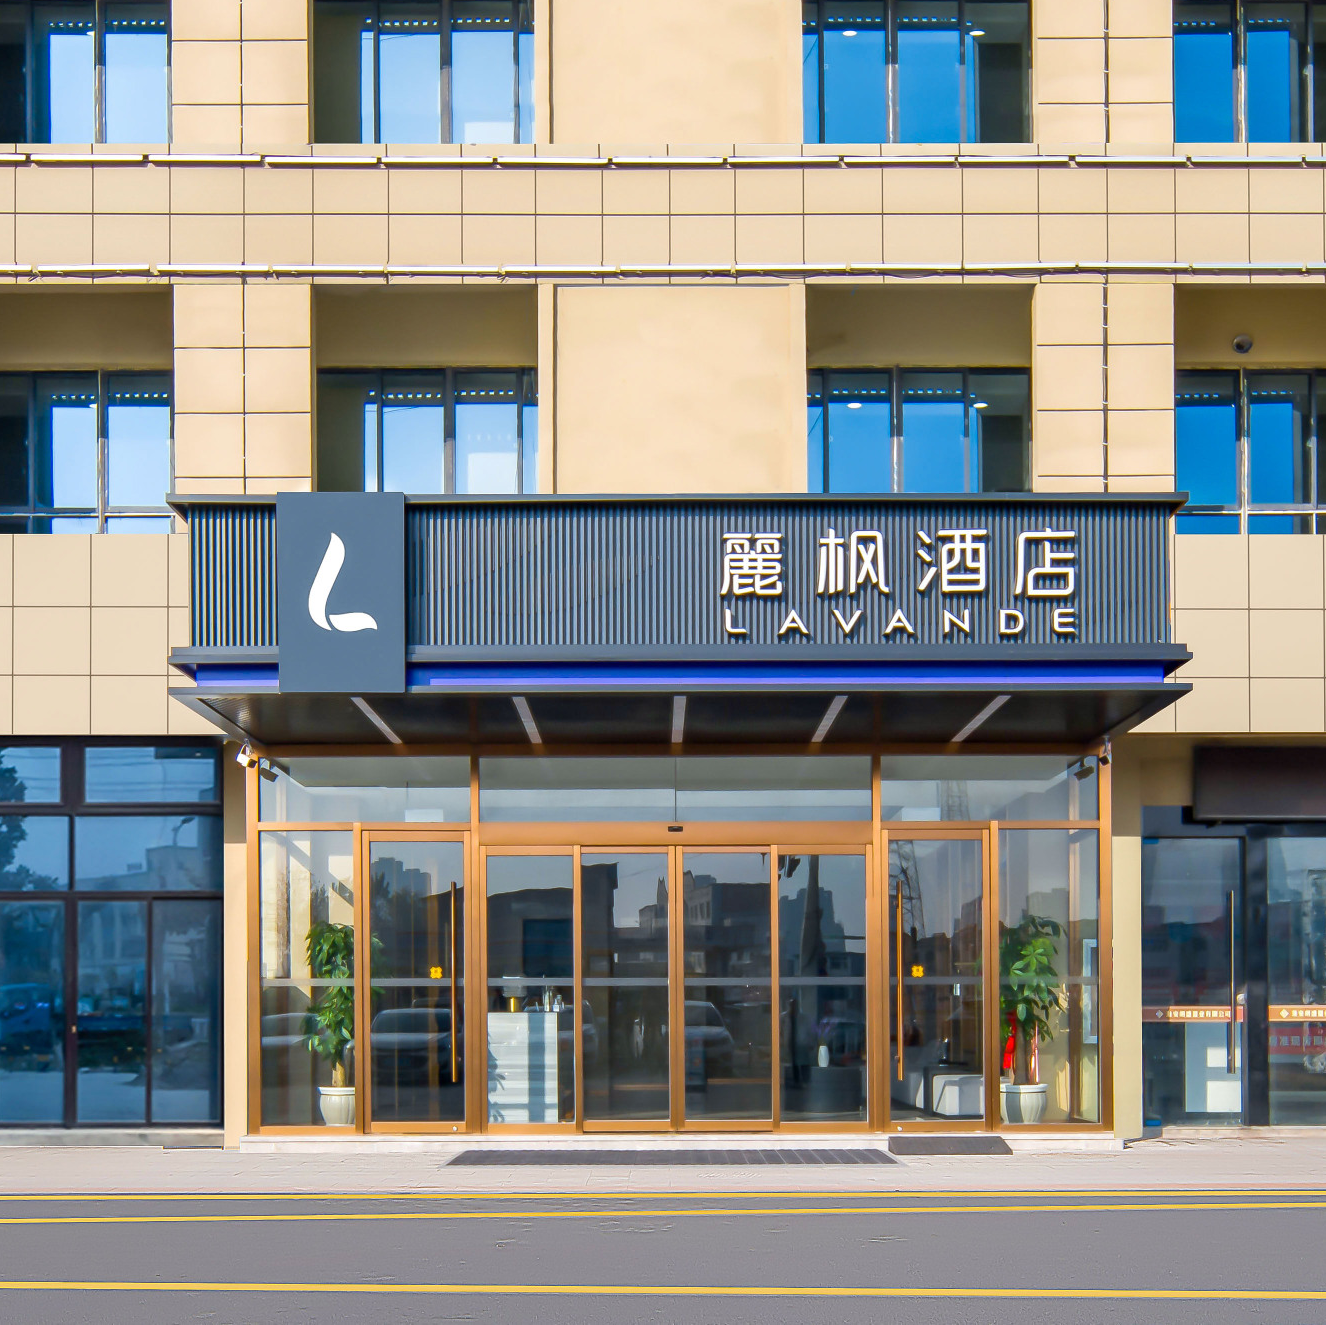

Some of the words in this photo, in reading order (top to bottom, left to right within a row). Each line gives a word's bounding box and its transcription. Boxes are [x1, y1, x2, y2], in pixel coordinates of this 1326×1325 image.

[720, 527, 1076, 596] 麗枫酒店
[724, 608, 1076, 635] LAVANDE
